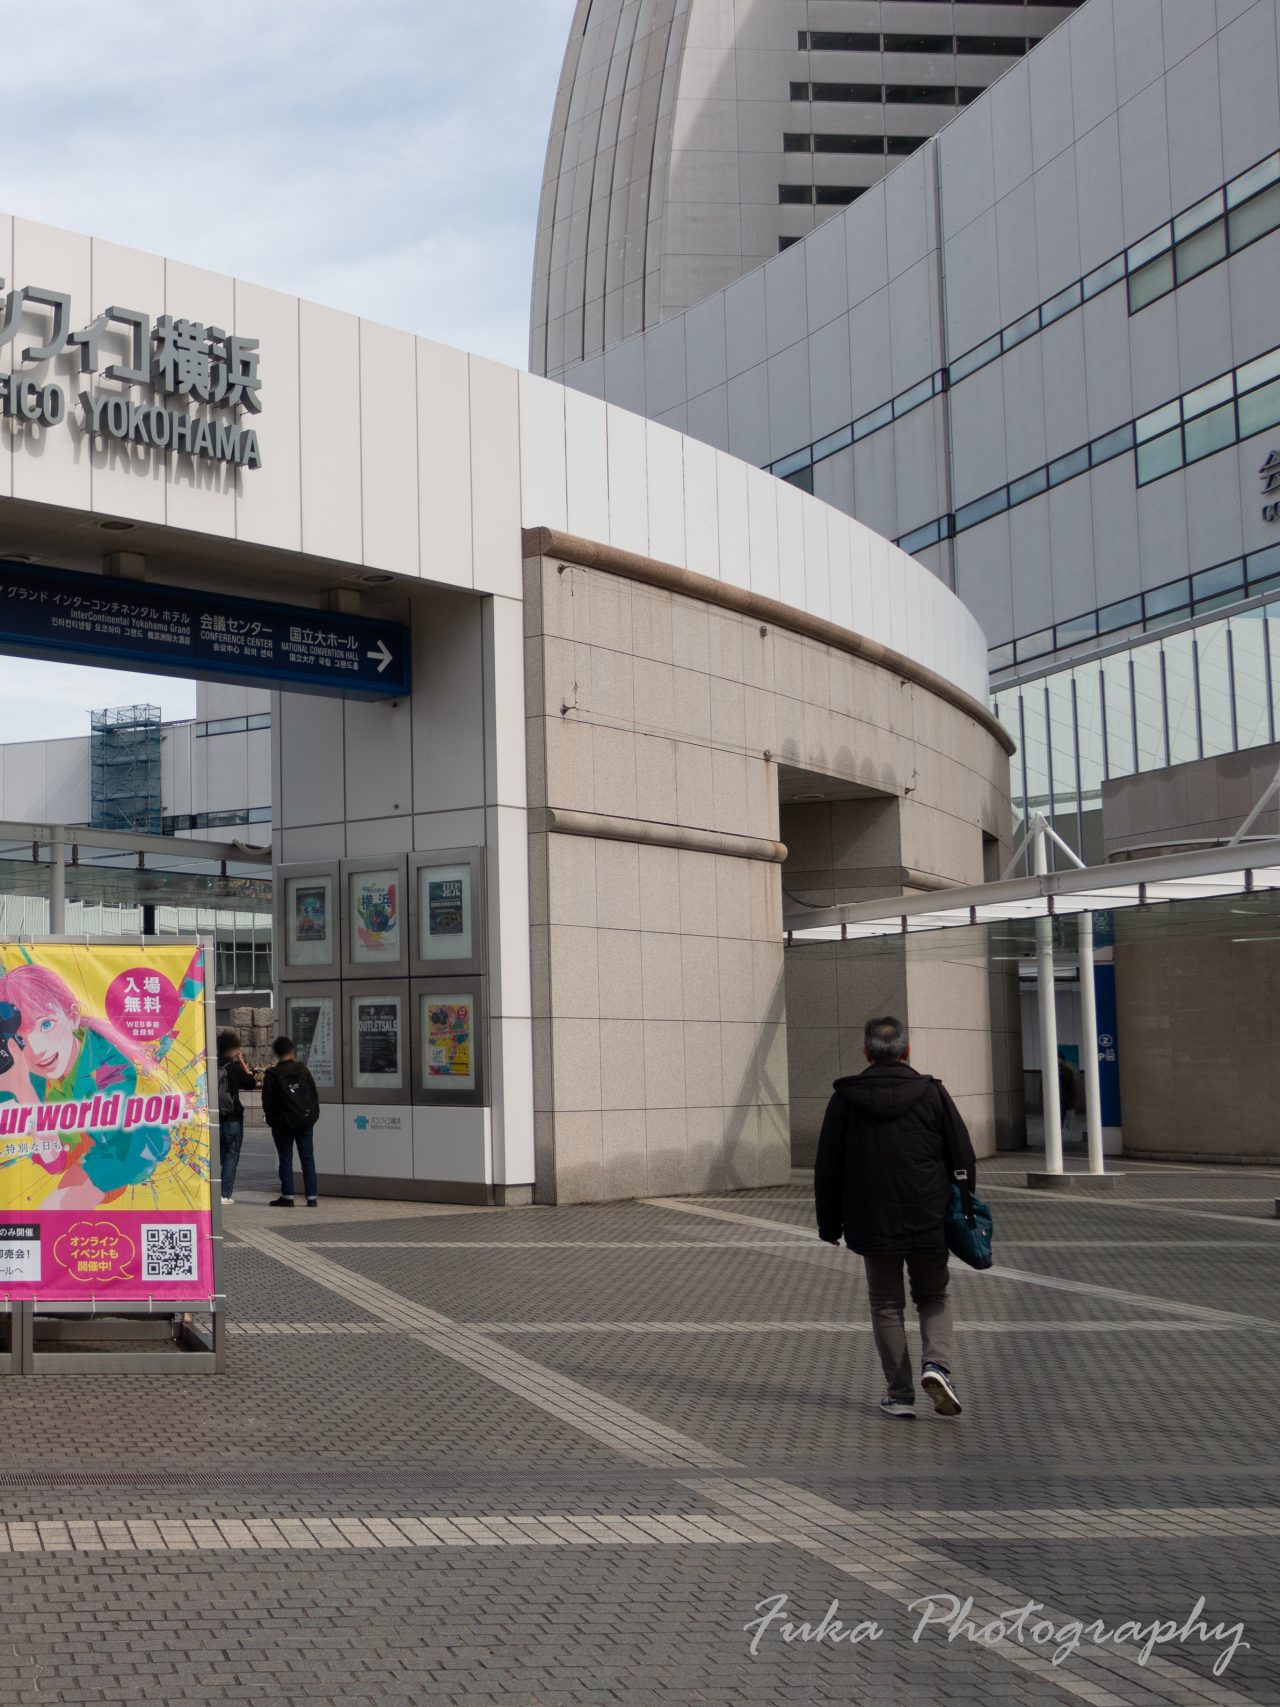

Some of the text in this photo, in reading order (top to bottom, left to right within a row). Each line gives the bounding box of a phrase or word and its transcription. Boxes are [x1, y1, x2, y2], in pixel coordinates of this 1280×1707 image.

[79, 390, 262, 470] YOKOHAMA
[7, 586, 48, 603] グランド
[52, 593, 158, 619] インターコンチネンタル
[162, 610, 190, 624] ホテル
[70, 608, 191, 636] InterContinental Yokohama Grand
[200, 613, 273, 636] 会議センター
[200, 630, 273, 649] CONFERENCE CENTER
[289, 626, 358, 649] 国立大ホール
[281, 642, 360, 661] NATIONAL CONVENTION HALL
[124, 976, 161, 994] 入場
[124, 996, 161, 1013] 無料
[35, 1093, 121, 1132] world
[123, 1093, 189, 1128] pop.
[70, 1236, 119, 1247] オンライン
[71, 1248, 119, 1259] イベントも
